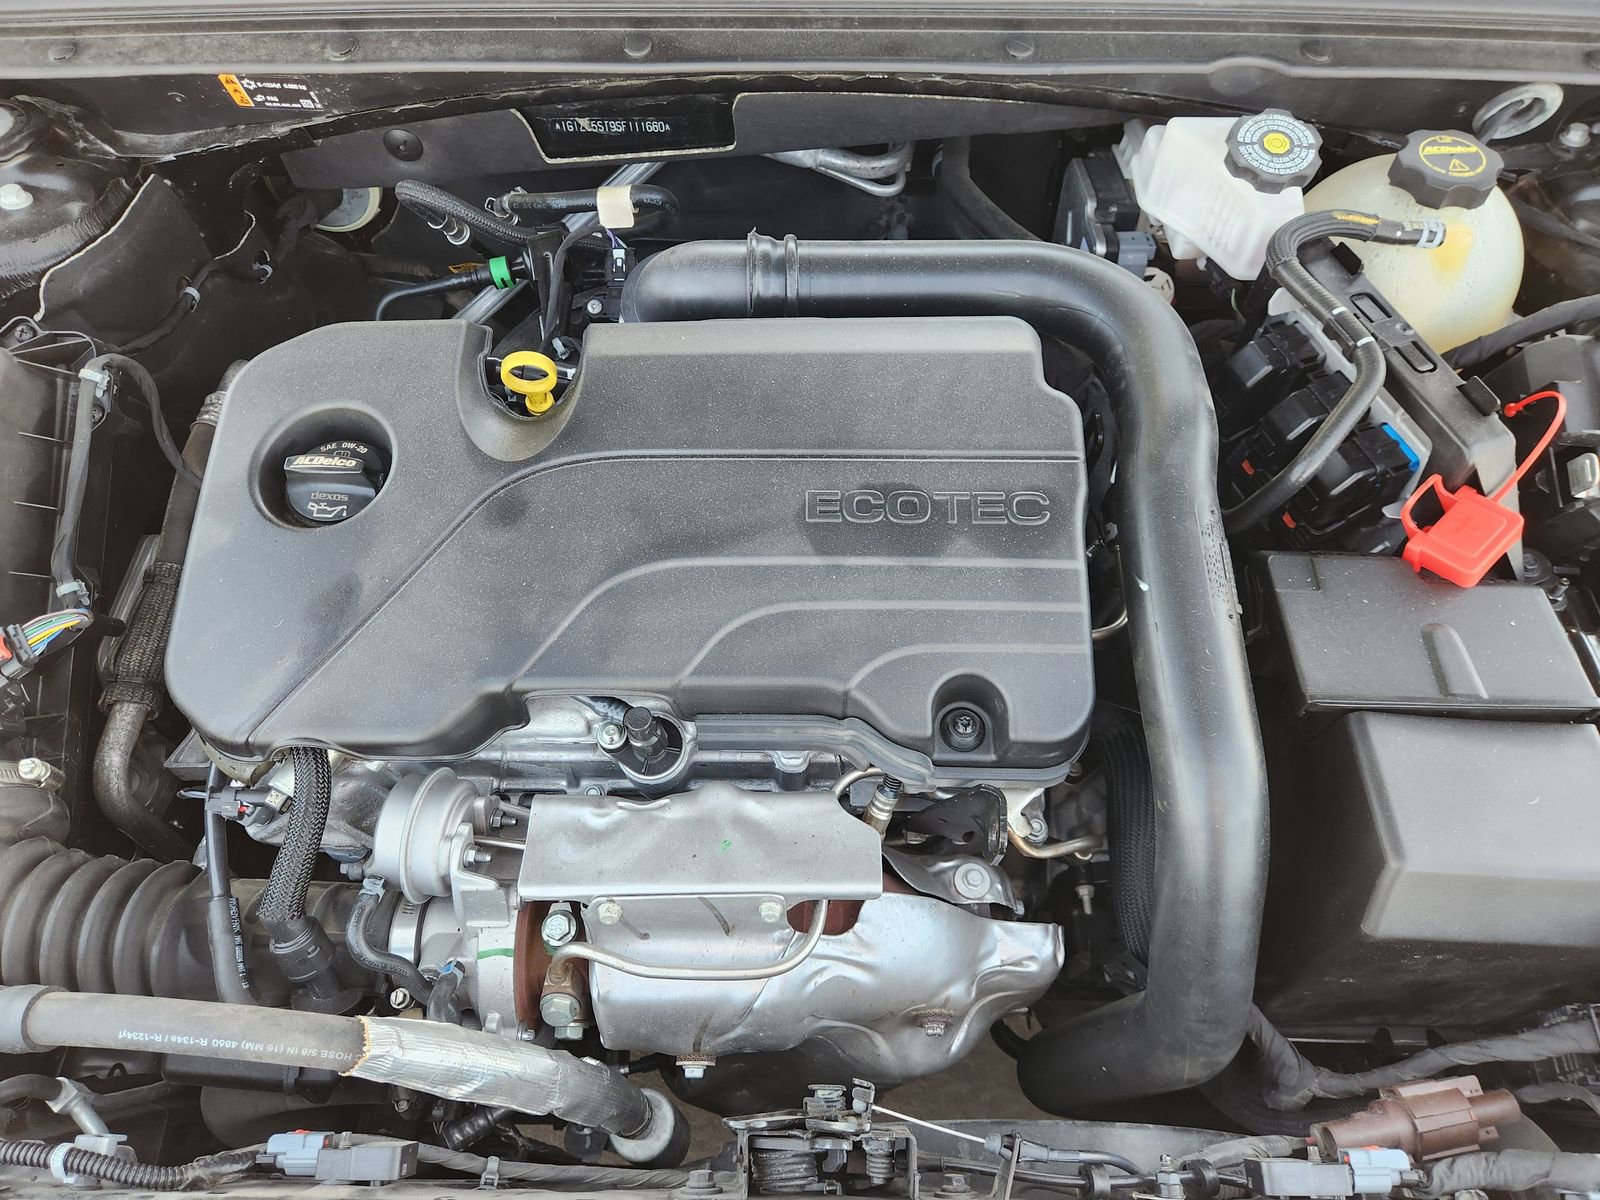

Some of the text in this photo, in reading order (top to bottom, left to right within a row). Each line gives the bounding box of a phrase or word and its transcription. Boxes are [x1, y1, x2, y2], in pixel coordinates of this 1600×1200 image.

[320, 441, 368, 454] SAE 0W-20
[292, 456, 357, 467] ACDelco
[310, 490, 349, 502] dexos
[805, 489, 1051, 526] ECOTEC
[118, 1029, 162, 1042] R-1234yf
[171, 1034, 208, 1047] R-134a
[212, 1038, 239, 1049] 4860
[241, 1039, 264, 1052] MM)
[267, 1044, 284, 1054] (16
[286, 1046, 298, 1055] IN
[301, 1047, 318, 1057] 5/8
[320, 1049, 353, 1061] HOSE
